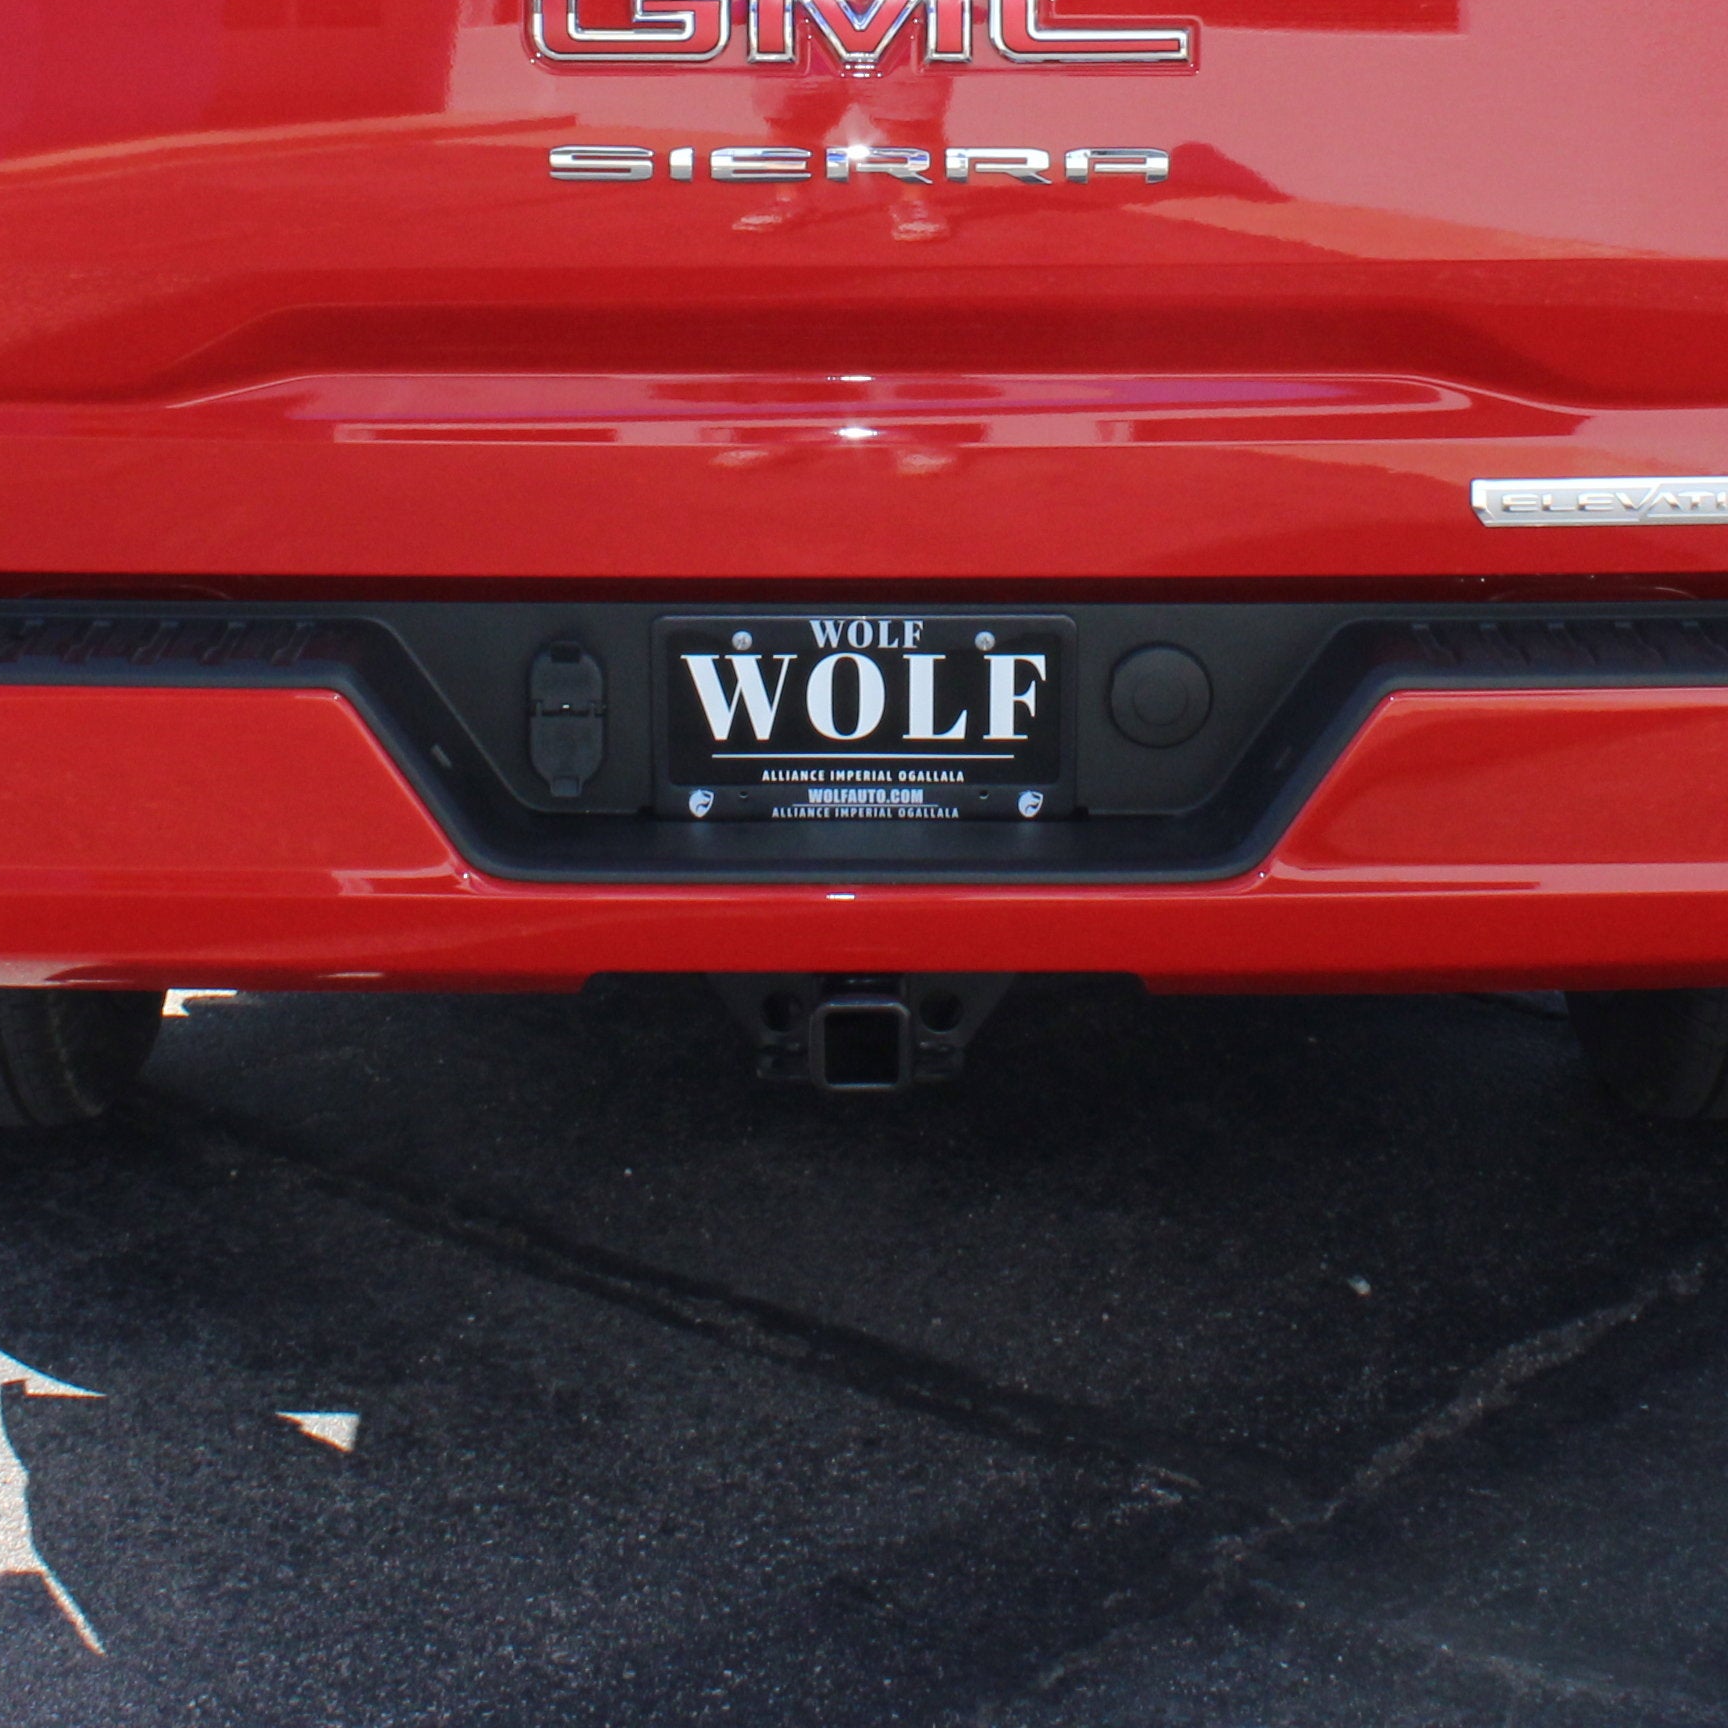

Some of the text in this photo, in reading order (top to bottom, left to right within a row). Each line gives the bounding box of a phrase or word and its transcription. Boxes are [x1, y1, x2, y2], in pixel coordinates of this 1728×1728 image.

[548, 144, 1170, 184] SIERRA
[809, 618, 925, 649] WOLF
[680, 652, 1047, 741] WOLF
[761, 769, 965, 783] ALLIANCE IMPERIAL OGALLALA
[808, 788, 924, 804] WOLFAUTO.COM
[772, 807, 960, 819] ALLIANCE IMPERIAL OGALLALA
